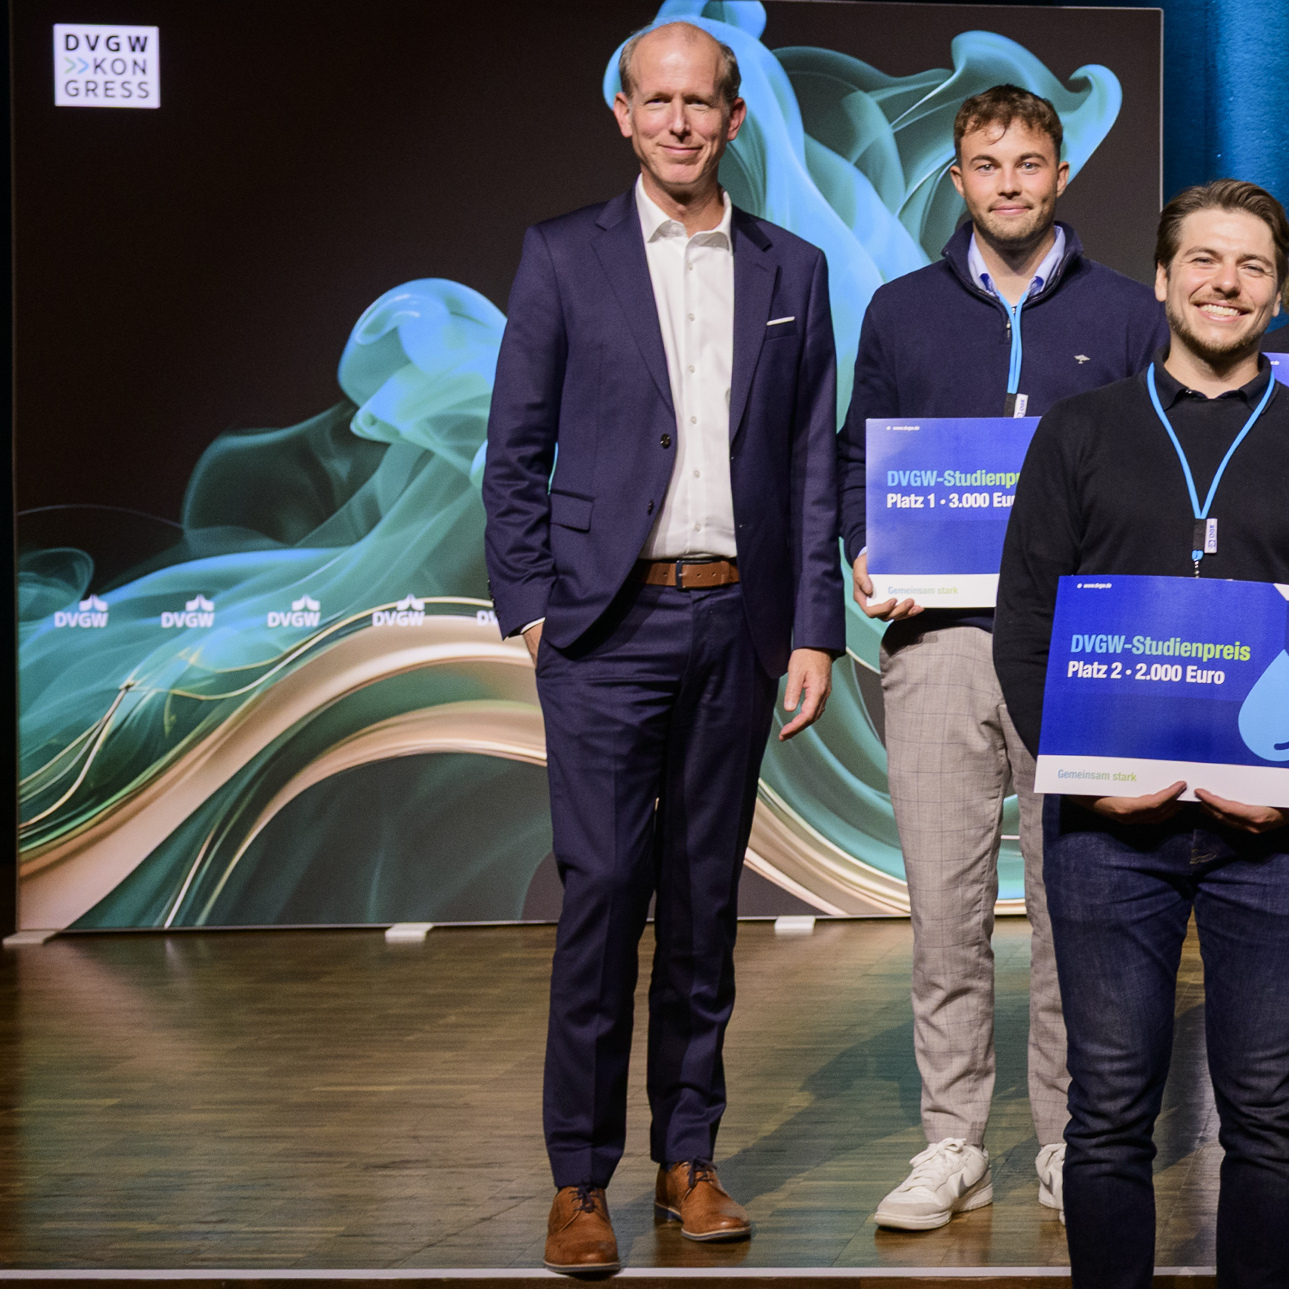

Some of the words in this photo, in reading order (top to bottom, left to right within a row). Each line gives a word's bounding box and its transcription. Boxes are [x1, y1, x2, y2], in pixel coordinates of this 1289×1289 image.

[65, 34, 147, 52] DVGW
[94, 58, 146, 75] KON
[65, 80, 149, 98] GRESS
[887, 470, 1020, 489] DVGW-Studienp
[887, 493, 924, 508] Platz
[927, 493, 935, 508] 1
[949, 493, 989, 508] 3.000
[993, 492, 1015, 508] Eu
[888, 586, 935, 594] Gemeinsam
[937, 586, 958, 594] stark
[54, 611, 109, 628] DVGW
[160, 611, 215, 628] DVGW
[267, 611, 321, 627] DVGW
[372, 611, 426, 627] DVGW
[476, 610, 498, 627] DV
[1070, 634, 1251, 662] DVGW-Studienpreis
[1067, 661, 1107, 679] Platz
[1110, 662, 1122, 679] 2
[1135, 663, 1183, 682] 2.000
[1186, 666, 1225, 685] Euro
[1057, 769, 1110, 780] Gemeinsam
[1112, 772, 1137, 782] stark
